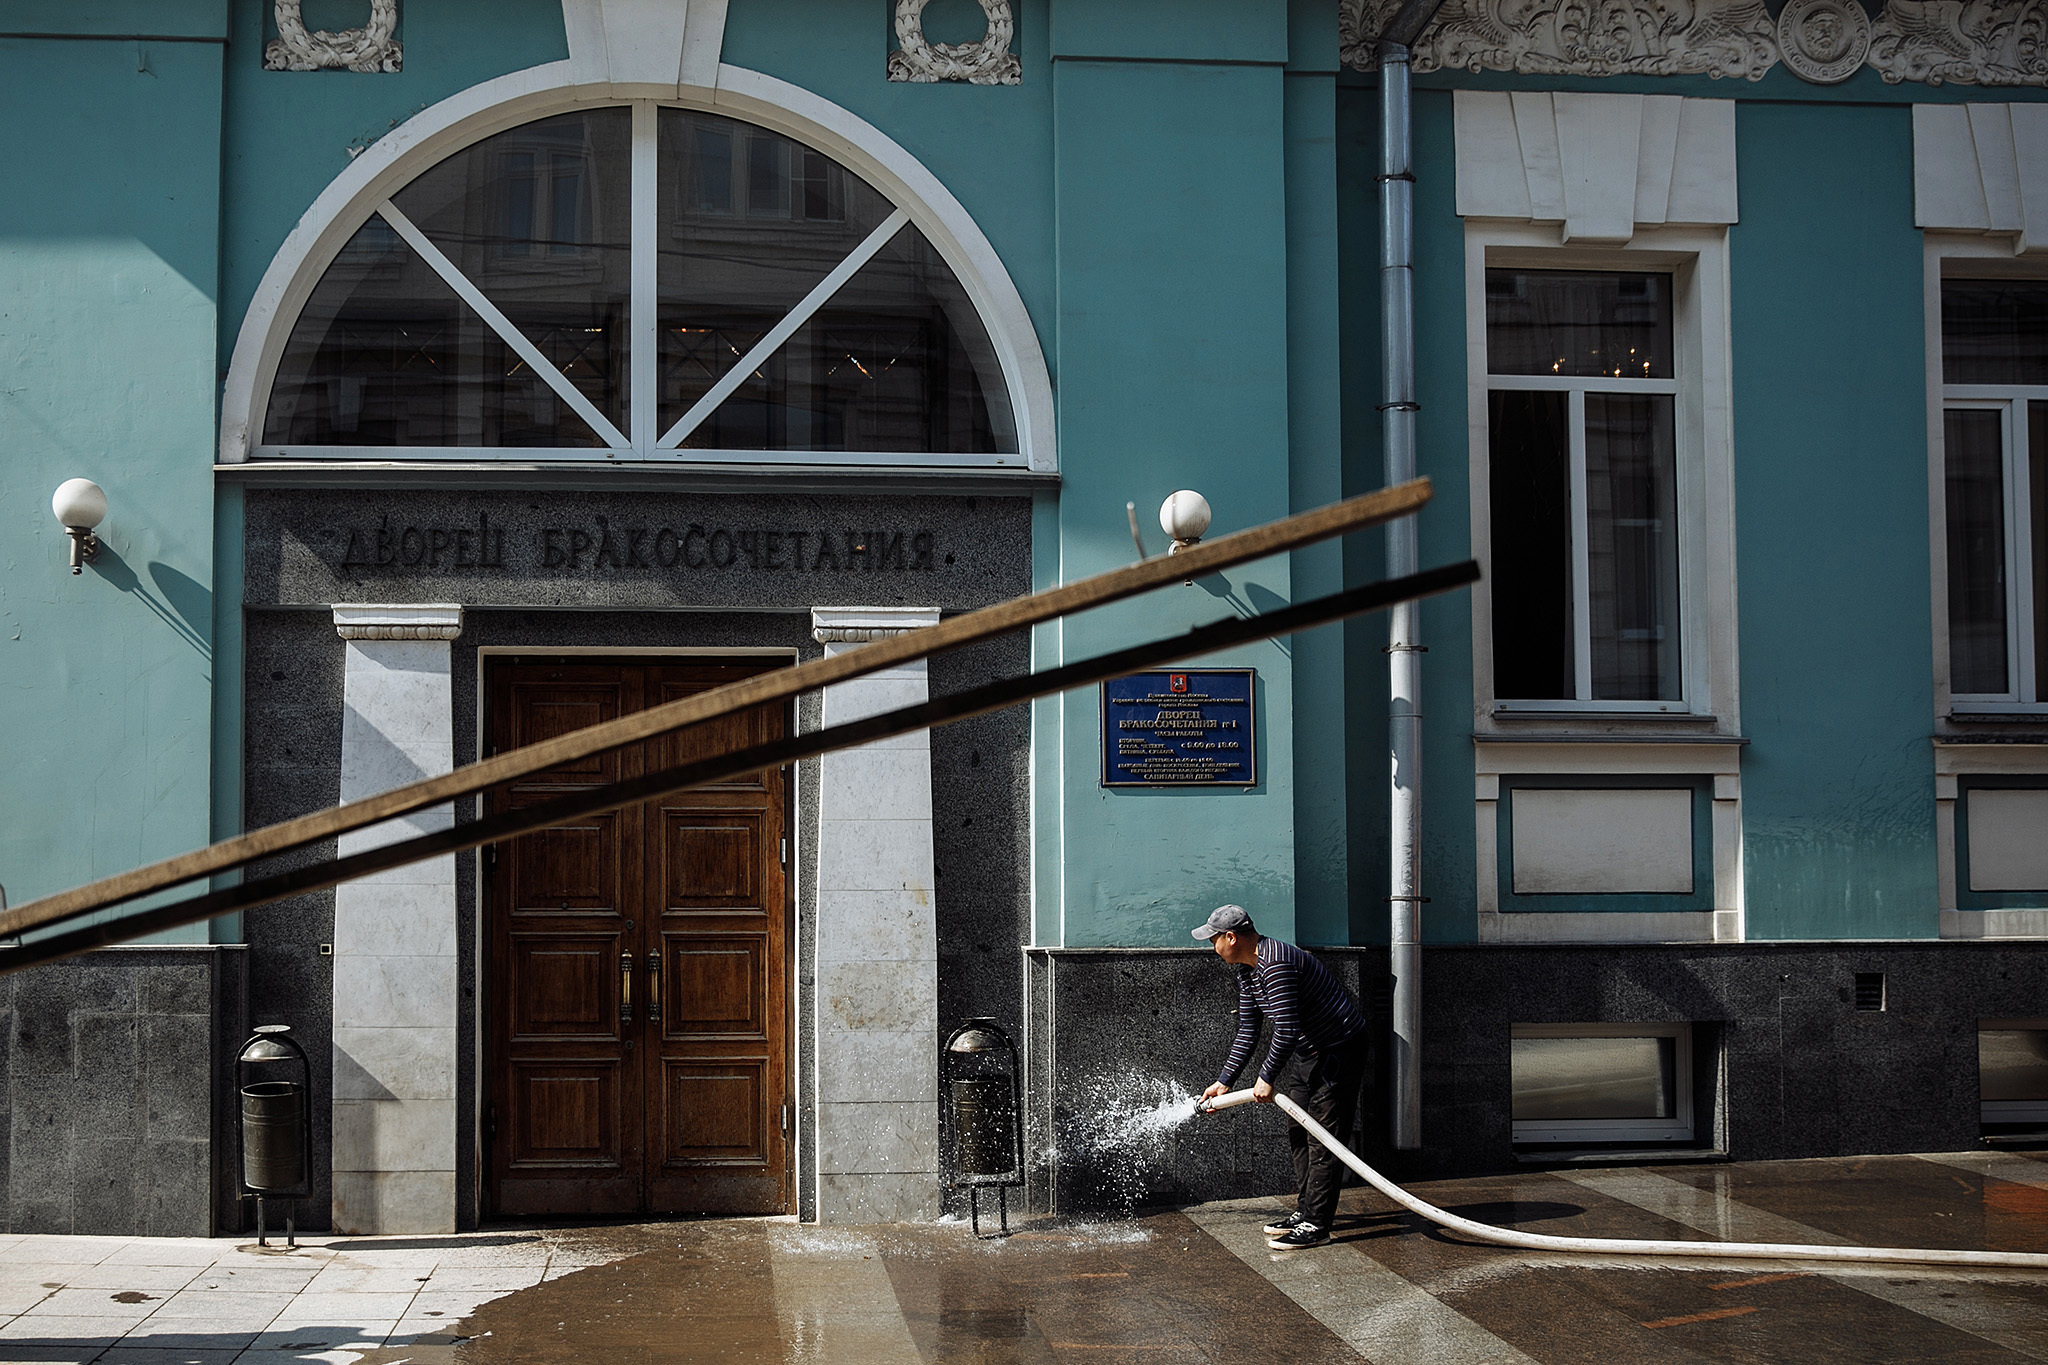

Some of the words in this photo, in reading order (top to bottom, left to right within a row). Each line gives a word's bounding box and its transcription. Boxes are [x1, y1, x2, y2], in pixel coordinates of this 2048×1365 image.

[341, 525, 502, 568] ДВОРЕЦ
[540, 526, 933, 570] БРАКОСОЧЕТАНИЯ
[1155, 711, 1201, 721] ДВОРЕЦ
[1119, 719, 1217, 728] БРАКОСОЧЕТАНИЯ
